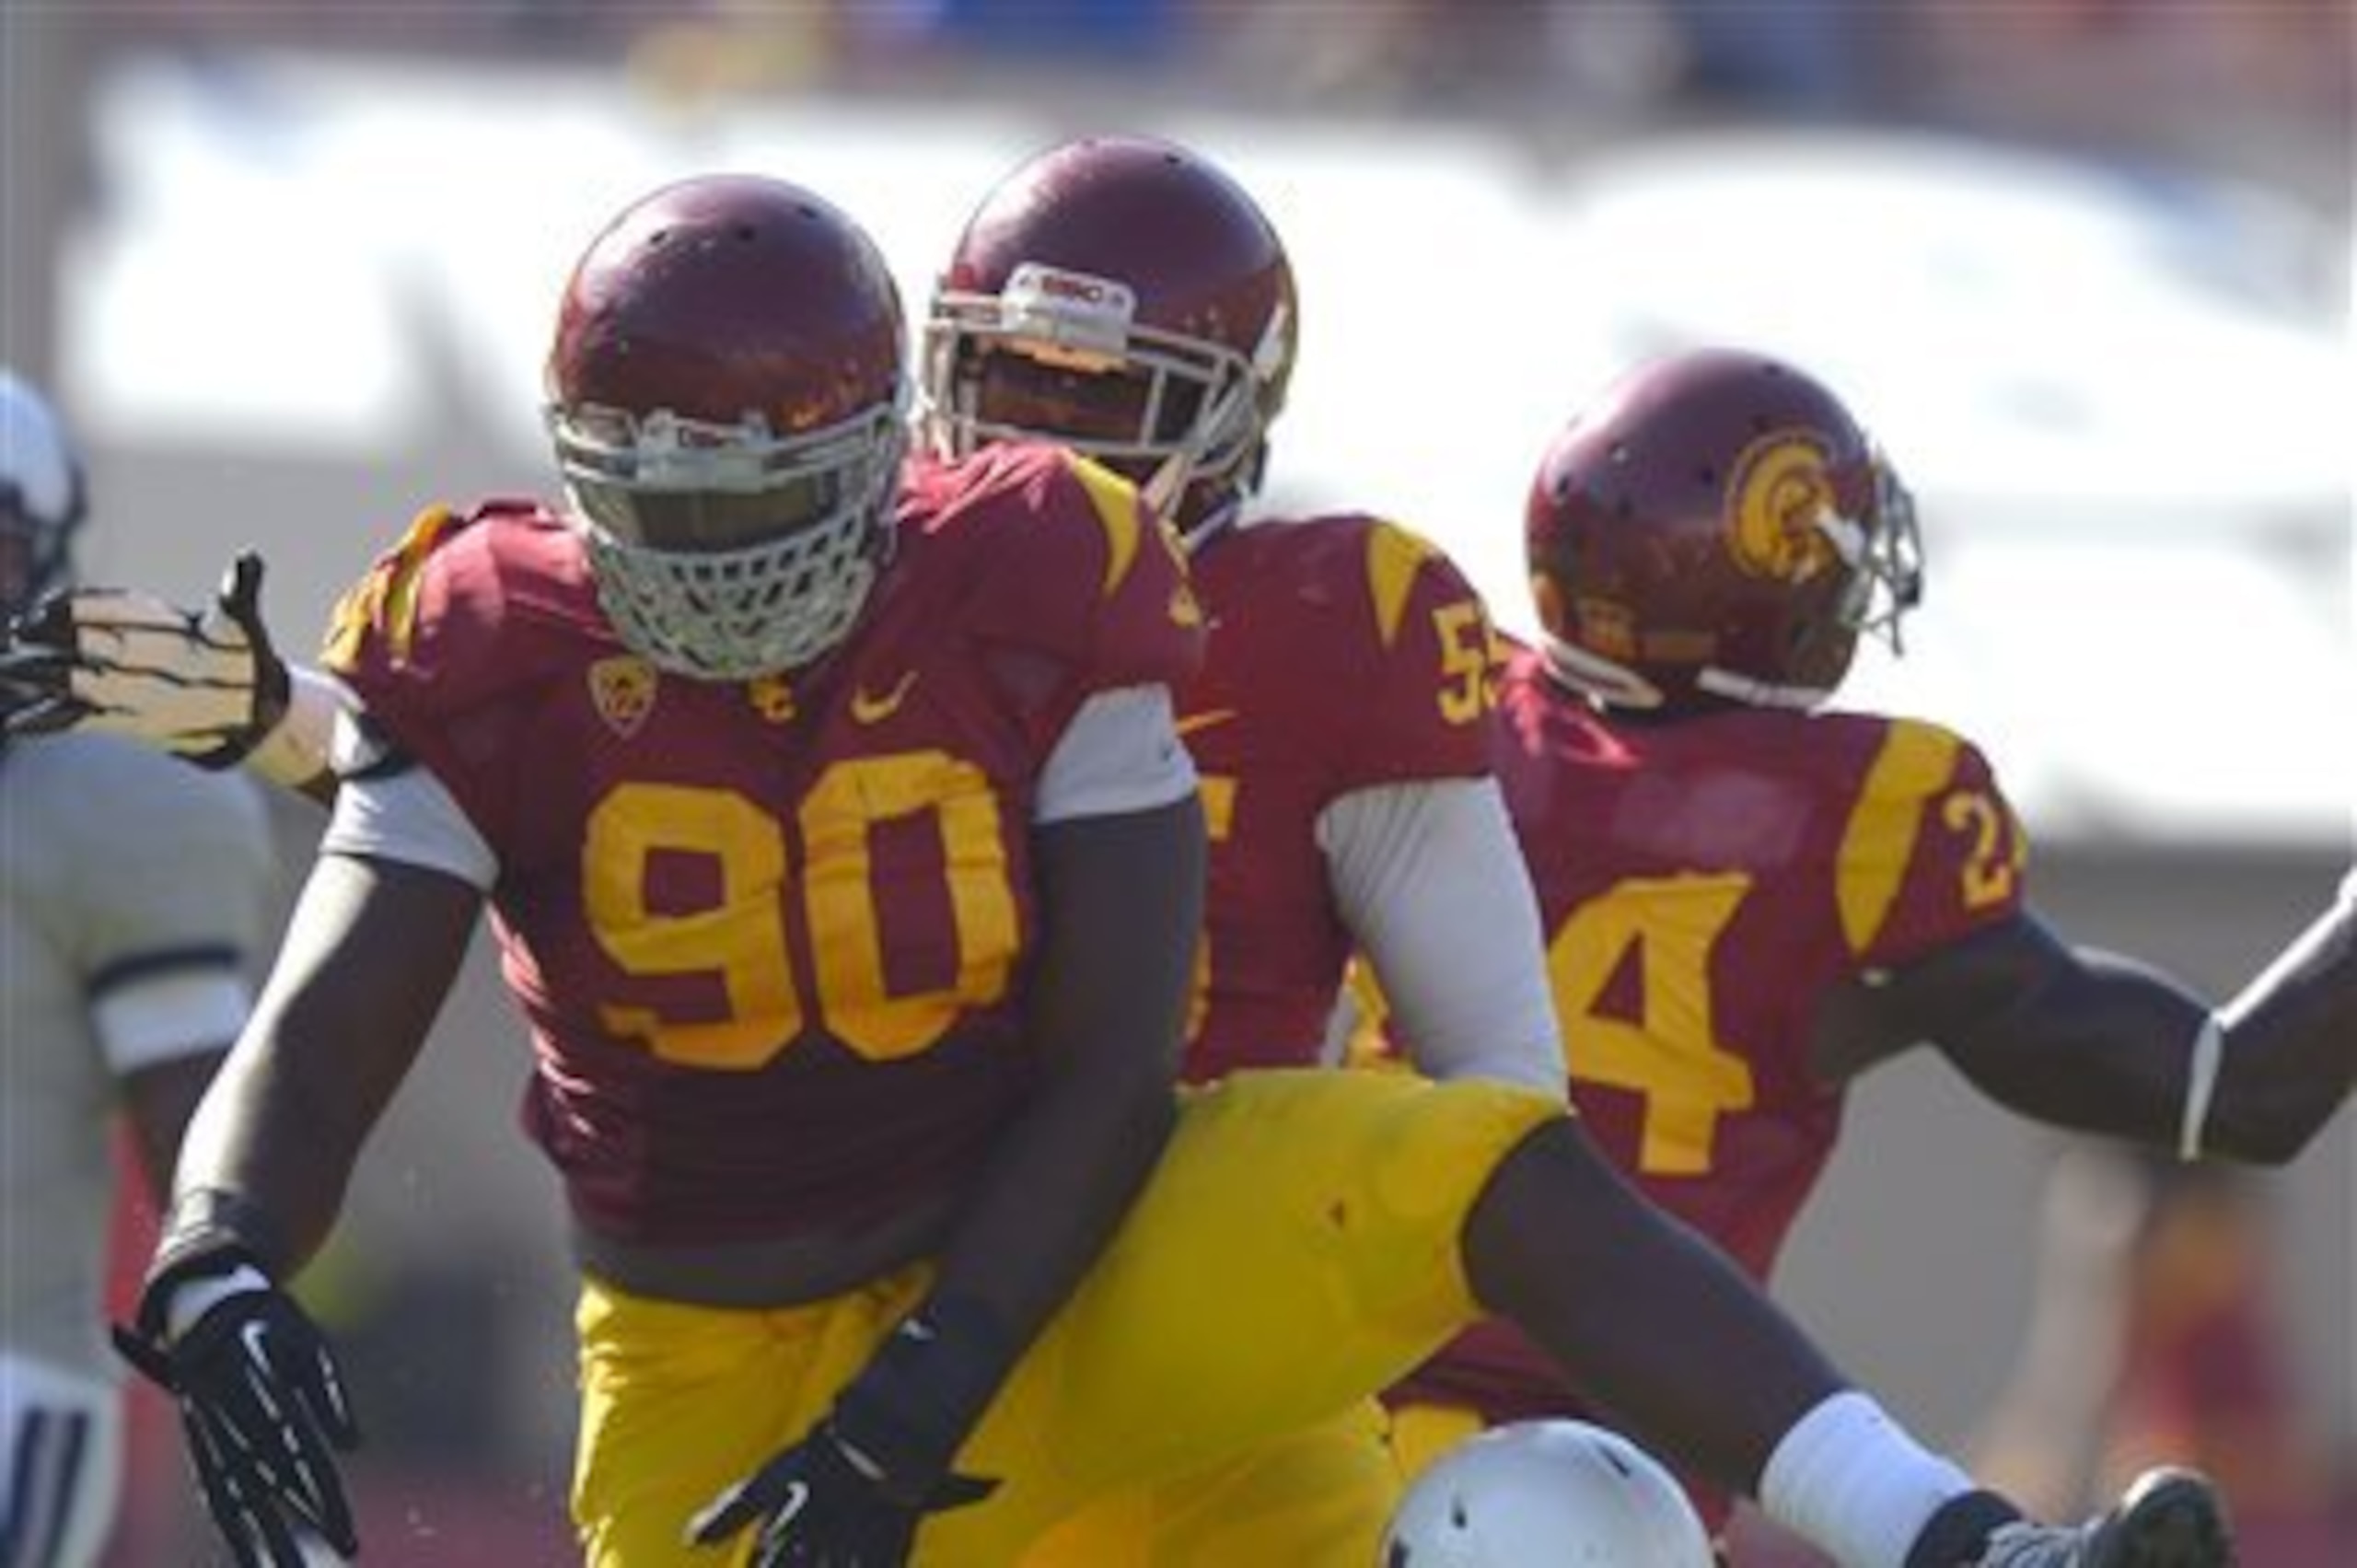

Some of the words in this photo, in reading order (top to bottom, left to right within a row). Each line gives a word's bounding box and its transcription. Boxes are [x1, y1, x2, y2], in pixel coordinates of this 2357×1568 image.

[582, 749, 1020, 1070] 90
[1941, 791, 2028, 907] 2
[1547, 870, 1755, 1175] 4
